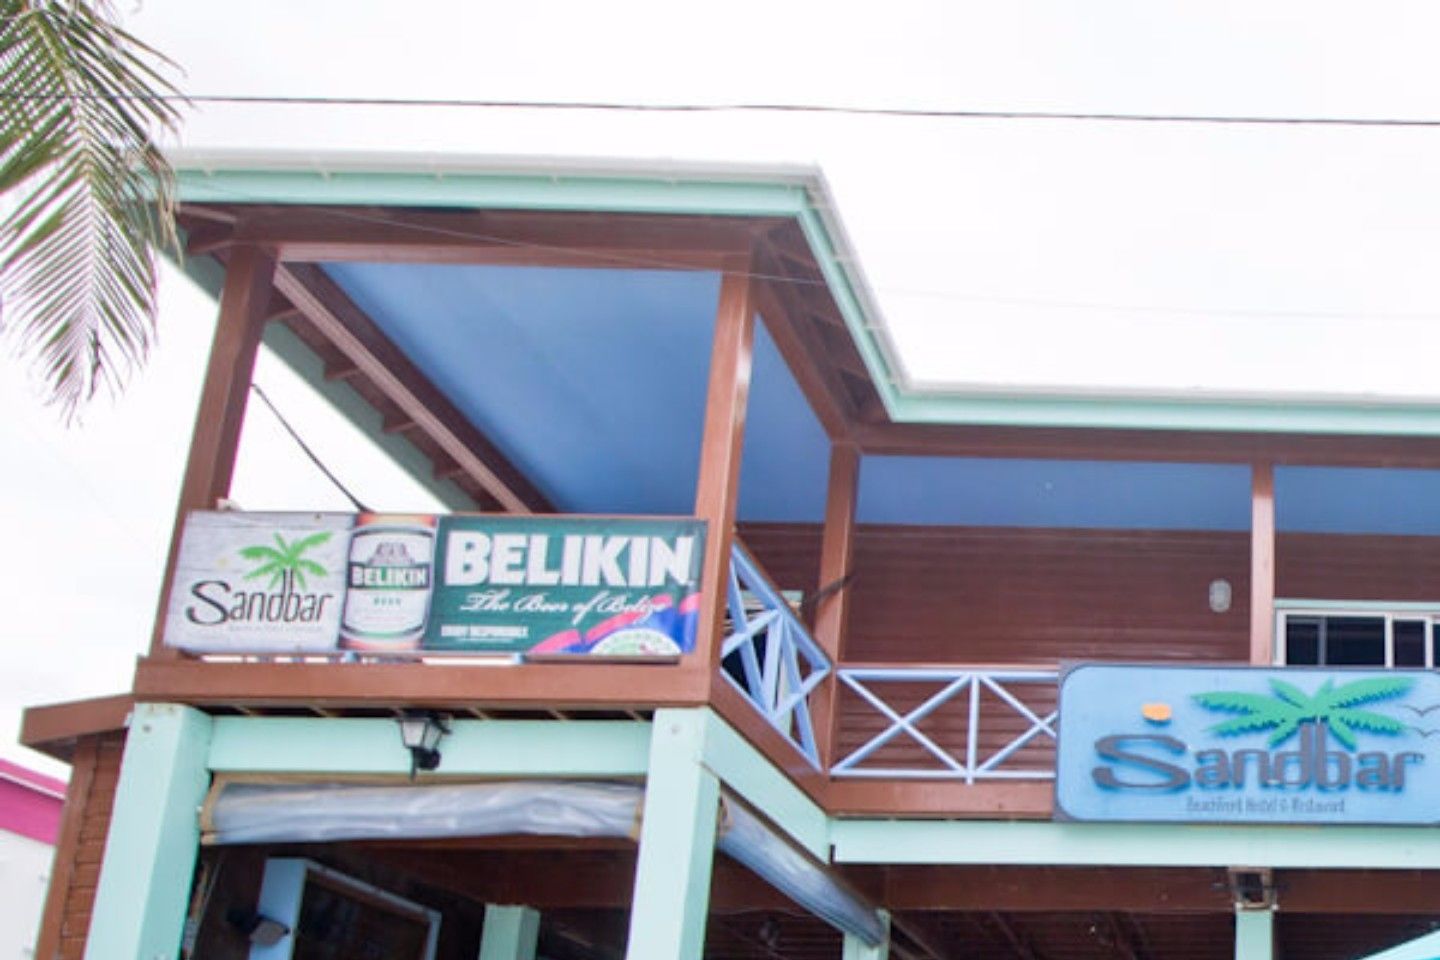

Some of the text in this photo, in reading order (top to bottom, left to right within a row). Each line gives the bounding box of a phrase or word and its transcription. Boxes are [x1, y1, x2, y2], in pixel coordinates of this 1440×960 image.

[445, 530, 694, 586] BELIKIN
[186, 568, 334, 626] Sandbar
[459, 588, 511, 612] The
[571, 590, 608, 625] of
[1091, 720, 1425, 791] Sandbar
